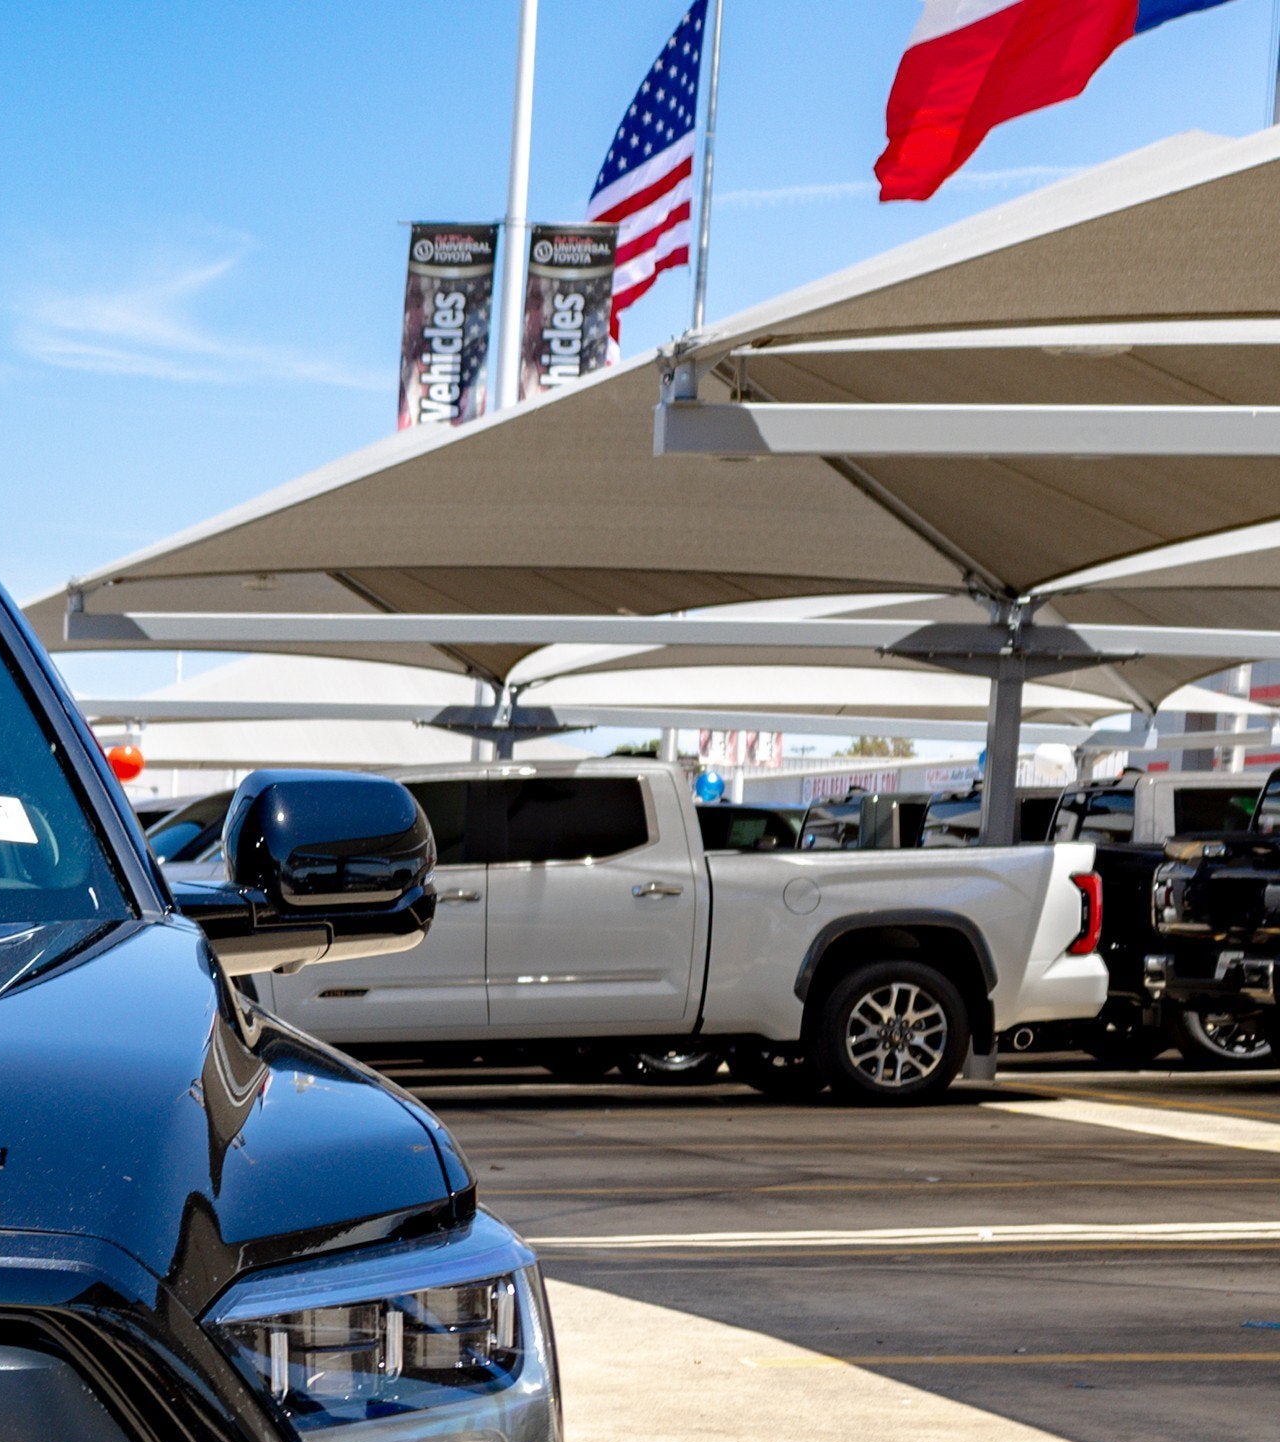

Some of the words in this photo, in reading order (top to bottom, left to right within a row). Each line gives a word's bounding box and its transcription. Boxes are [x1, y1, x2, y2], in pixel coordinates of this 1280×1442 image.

[434, 241, 492, 254] UNIVERSAL
[553, 243, 611, 256] UNIVERSAL
[434, 251, 473, 263] TOYOTA
[553, 253, 592, 264] TOYOTA
[540, 293, 585, 389] hicles
